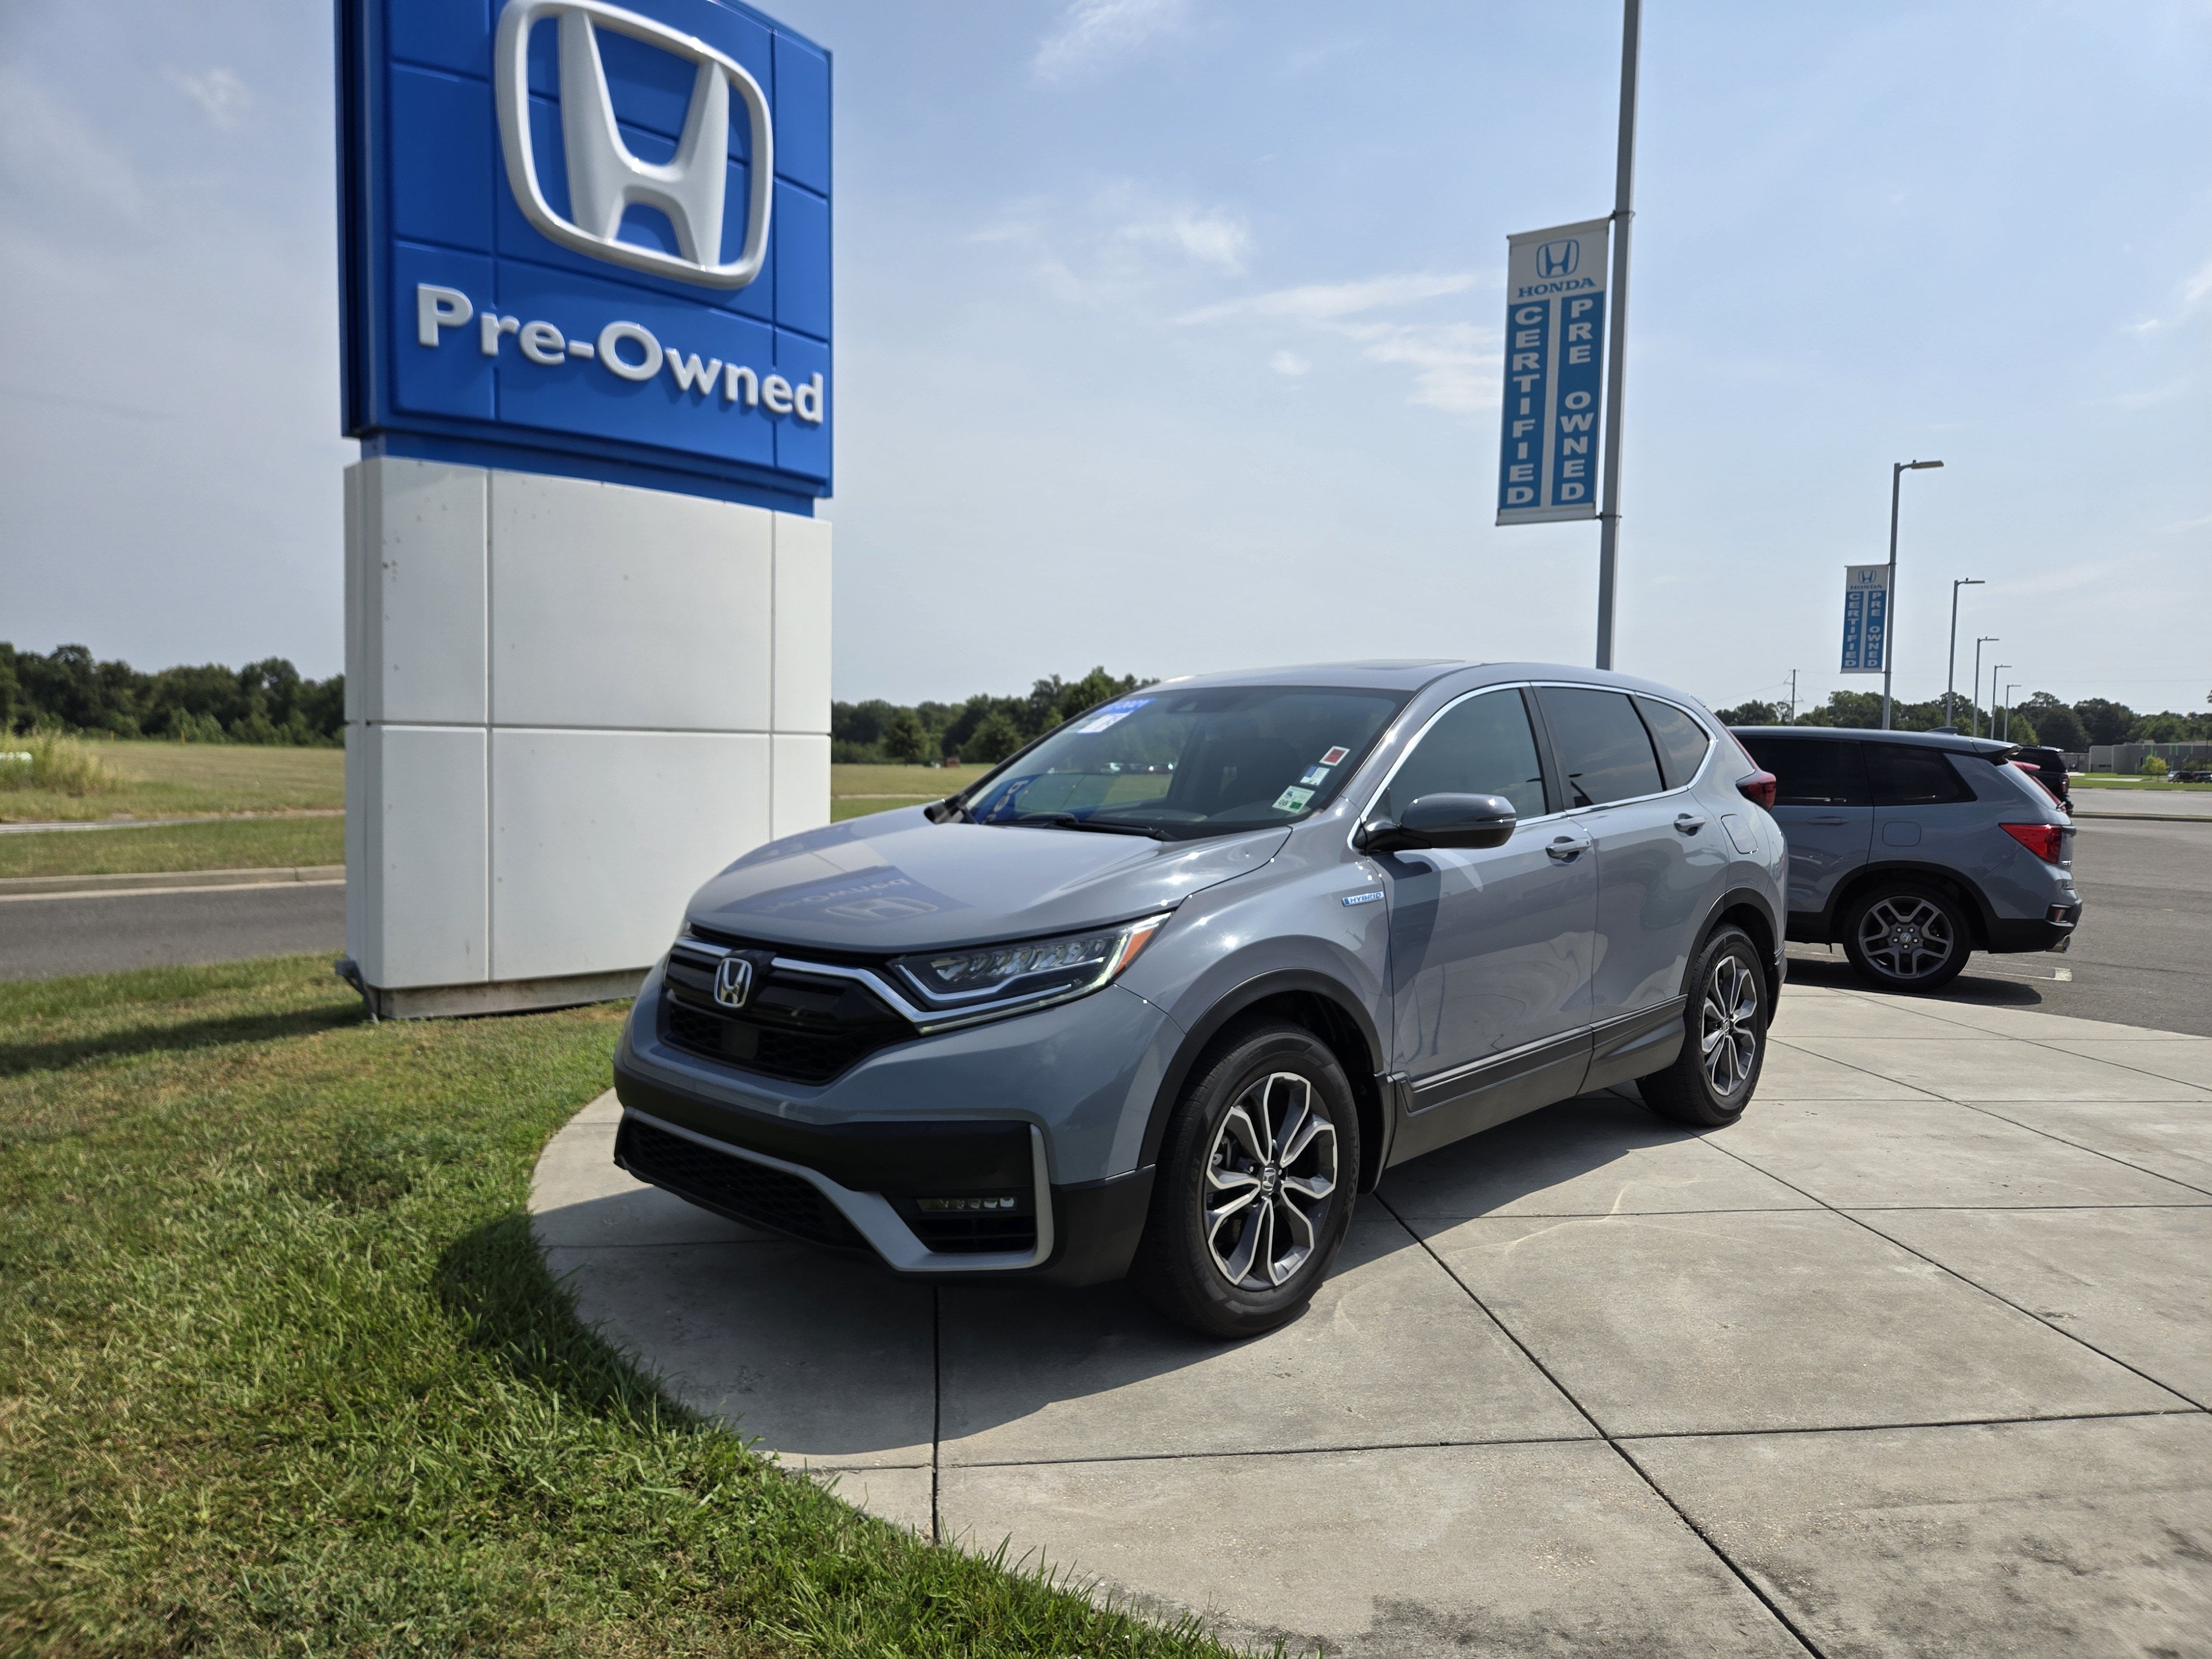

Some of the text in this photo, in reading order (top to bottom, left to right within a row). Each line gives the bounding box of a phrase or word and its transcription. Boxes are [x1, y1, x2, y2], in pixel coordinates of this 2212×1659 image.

[1517, 277, 1597, 298] HONDA
[417, 283, 824, 424] Pre-Owned
[1507, 306, 1543, 504] CERTIFIED
[1560, 298, 1594, 502] PRE OWNED
[1845, 592, 1861, 667] CERTIFIED
[1867, 592, 1882, 666] PRE OWNED
[1350, 893, 1381, 903] HYBRID
